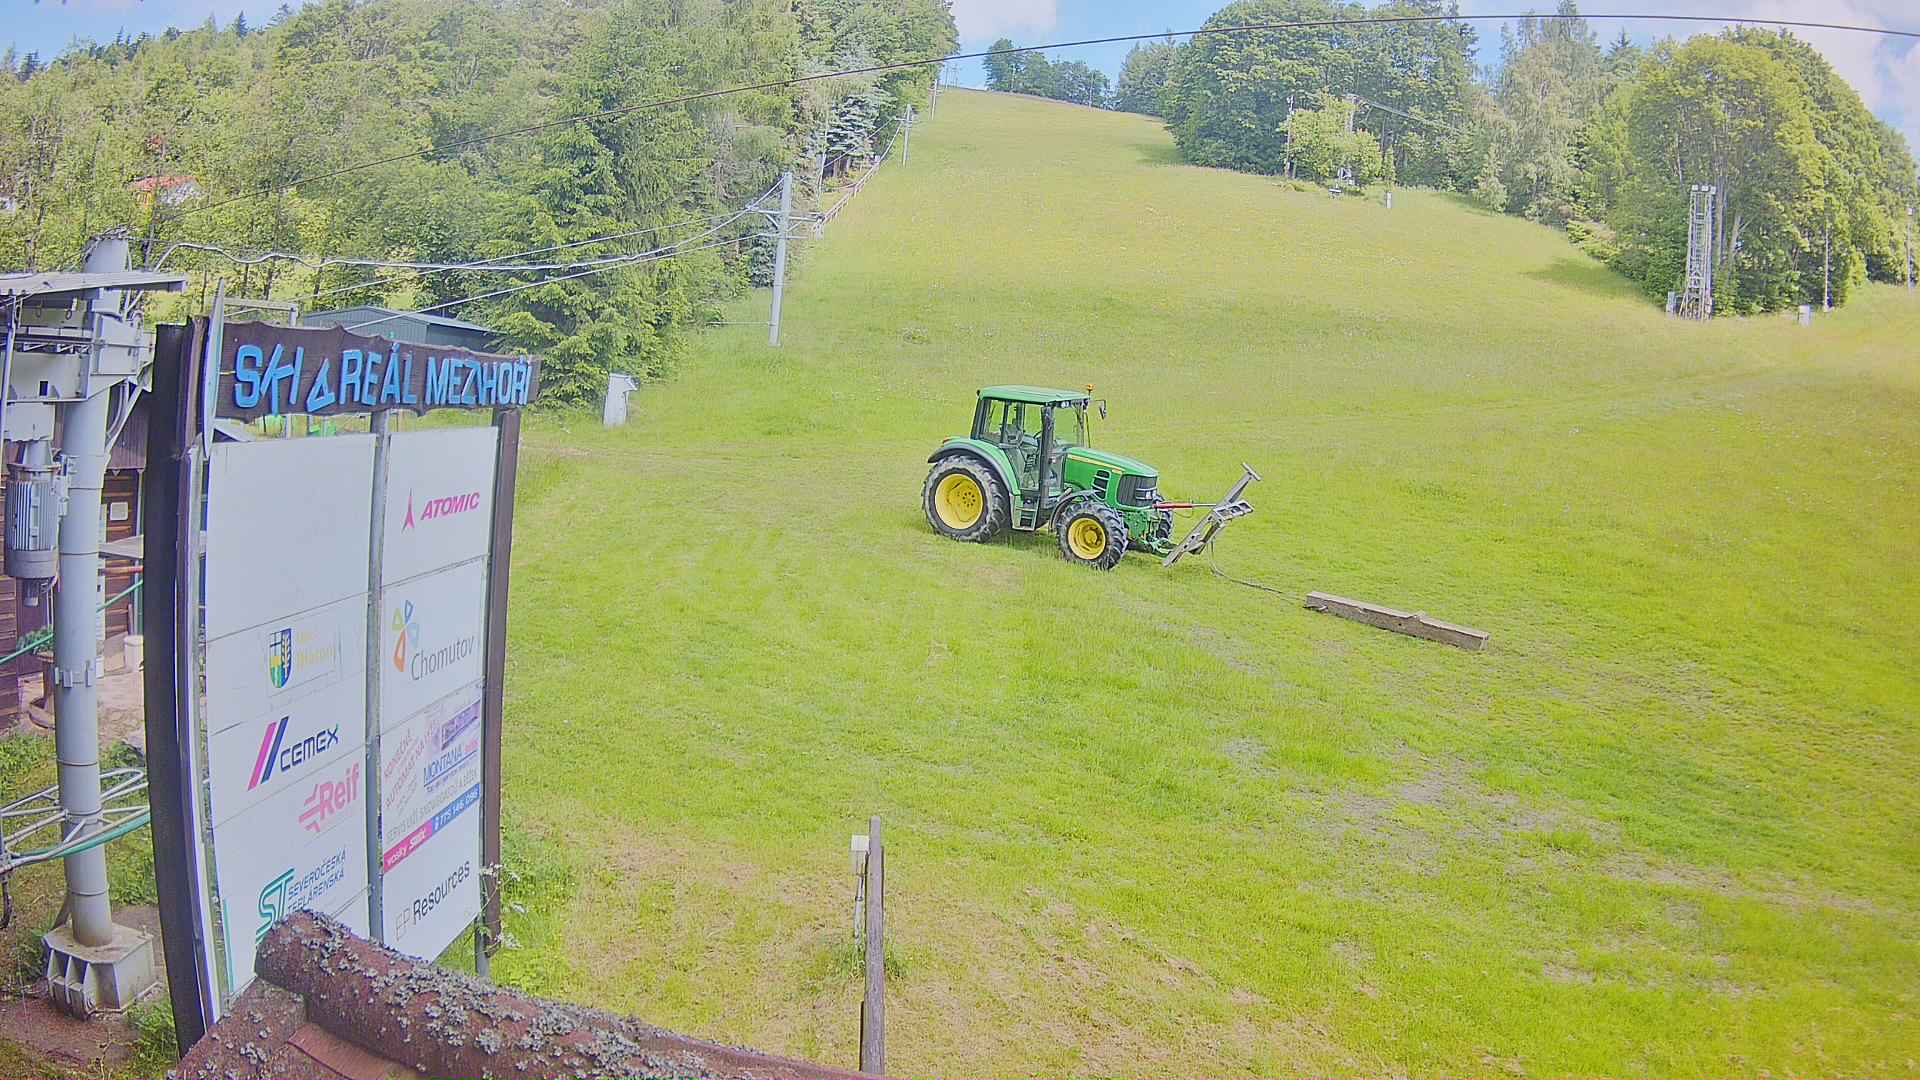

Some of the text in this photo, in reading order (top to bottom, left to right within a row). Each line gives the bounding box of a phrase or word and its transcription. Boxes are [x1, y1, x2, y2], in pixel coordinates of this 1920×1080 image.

[235, 343, 304, 415] SKI
[420, 492, 480, 521] ATOMIC
[411, 635, 475, 681] Chomutov
[280, 723, 339, 772] CEMEX
[424, 744, 463, 784] MONTANA
[319, 766, 360, 820] Reif
[413, 861, 470, 925] Resources
